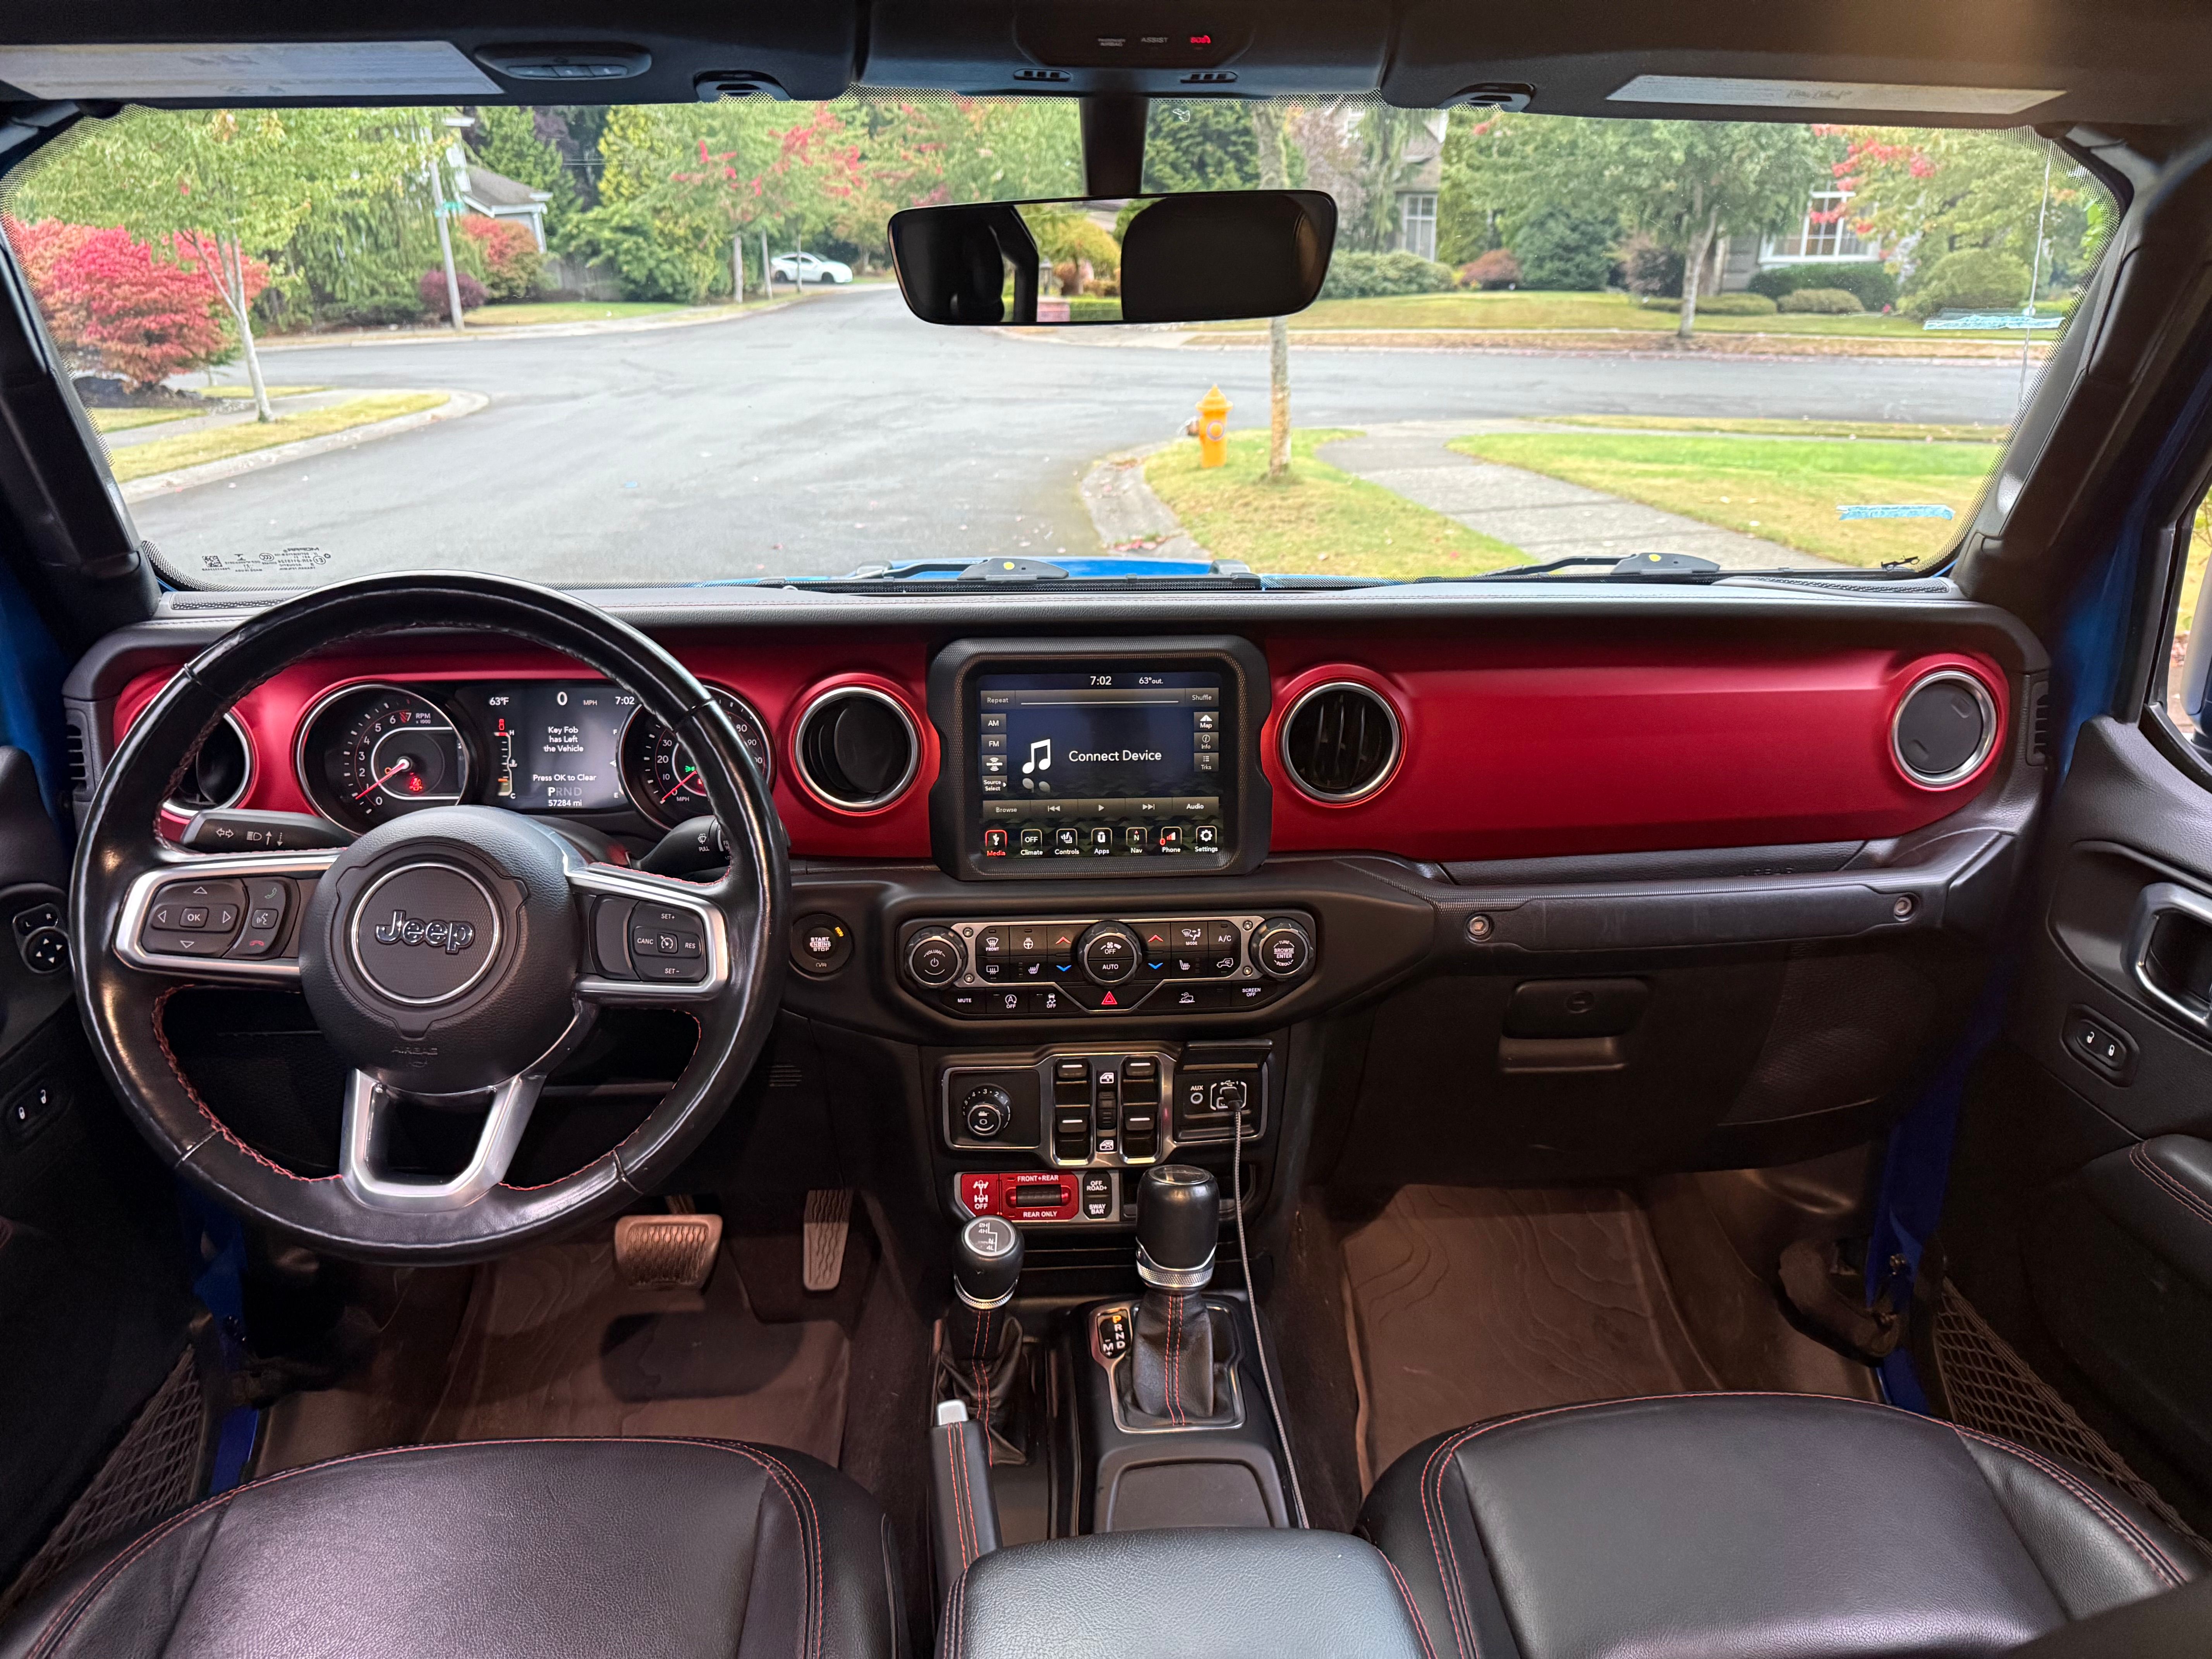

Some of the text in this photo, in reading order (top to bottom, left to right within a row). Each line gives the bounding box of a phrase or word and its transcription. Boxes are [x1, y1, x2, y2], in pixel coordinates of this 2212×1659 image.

[1090, 676, 1112, 685] 7:02
[557, 692, 567, 706] 0
[615, 697, 635, 705] 7:02
[390, 716, 396, 724] 6
[406, 713, 412, 721] 7
[375, 723, 381, 732] 5
[364, 736, 370, 744] 4
[359, 752, 365, 760] 3
[1068, 749, 1162, 762] Connect Device
[657, 756, 669, 764] 20
[359, 768, 365, 777] 2
[376, 797, 383, 805] 0
[187, 914, 200, 922] OK
[375, 909, 474, 954] Jeep
[1113, 1315, 1121, 1323] P
[1115, 1332, 1125, 1340] N
[1103, 1343, 1114, 1352] M
[1116, 1341, 1125, 1349] D
